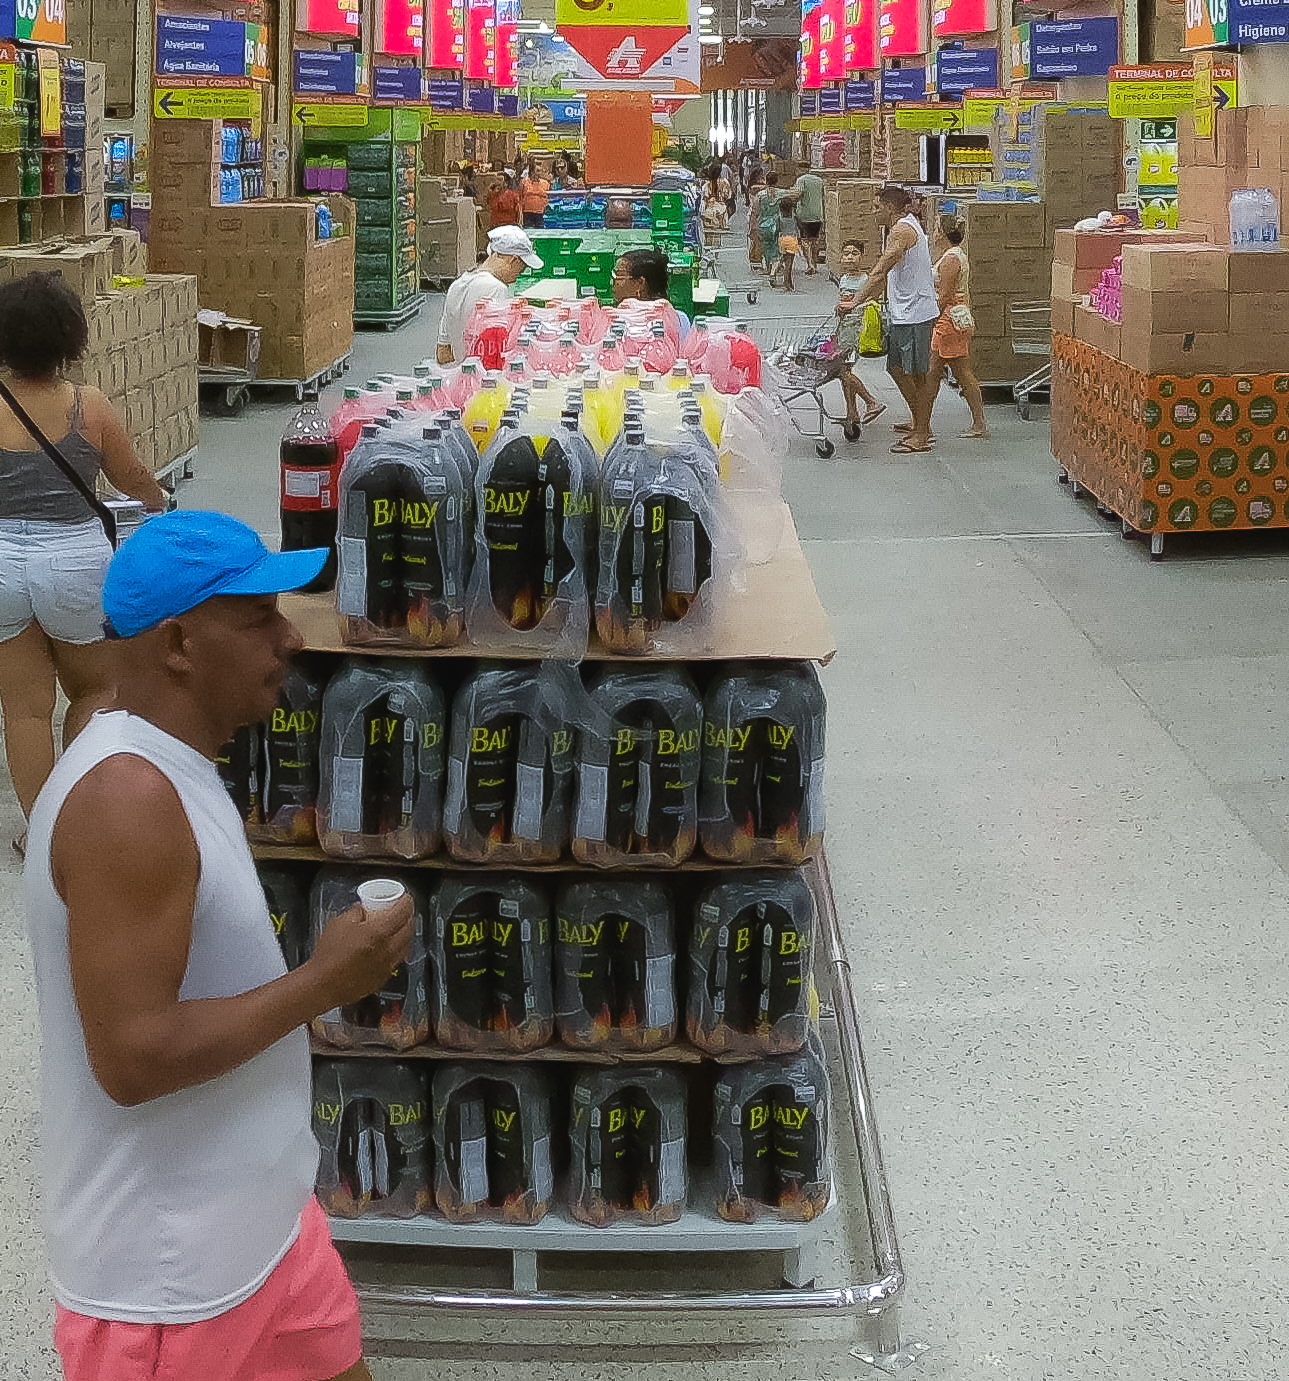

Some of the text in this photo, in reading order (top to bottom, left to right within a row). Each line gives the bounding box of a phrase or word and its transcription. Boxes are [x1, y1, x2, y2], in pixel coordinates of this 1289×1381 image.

[1238, 24, 1285, 40] Higiene
[483, 488, 530, 517] BALY
[471, 725, 512, 752] BAL
[452, 921, 487, 948] BAL
[557, 919, 604, 948] BALY
